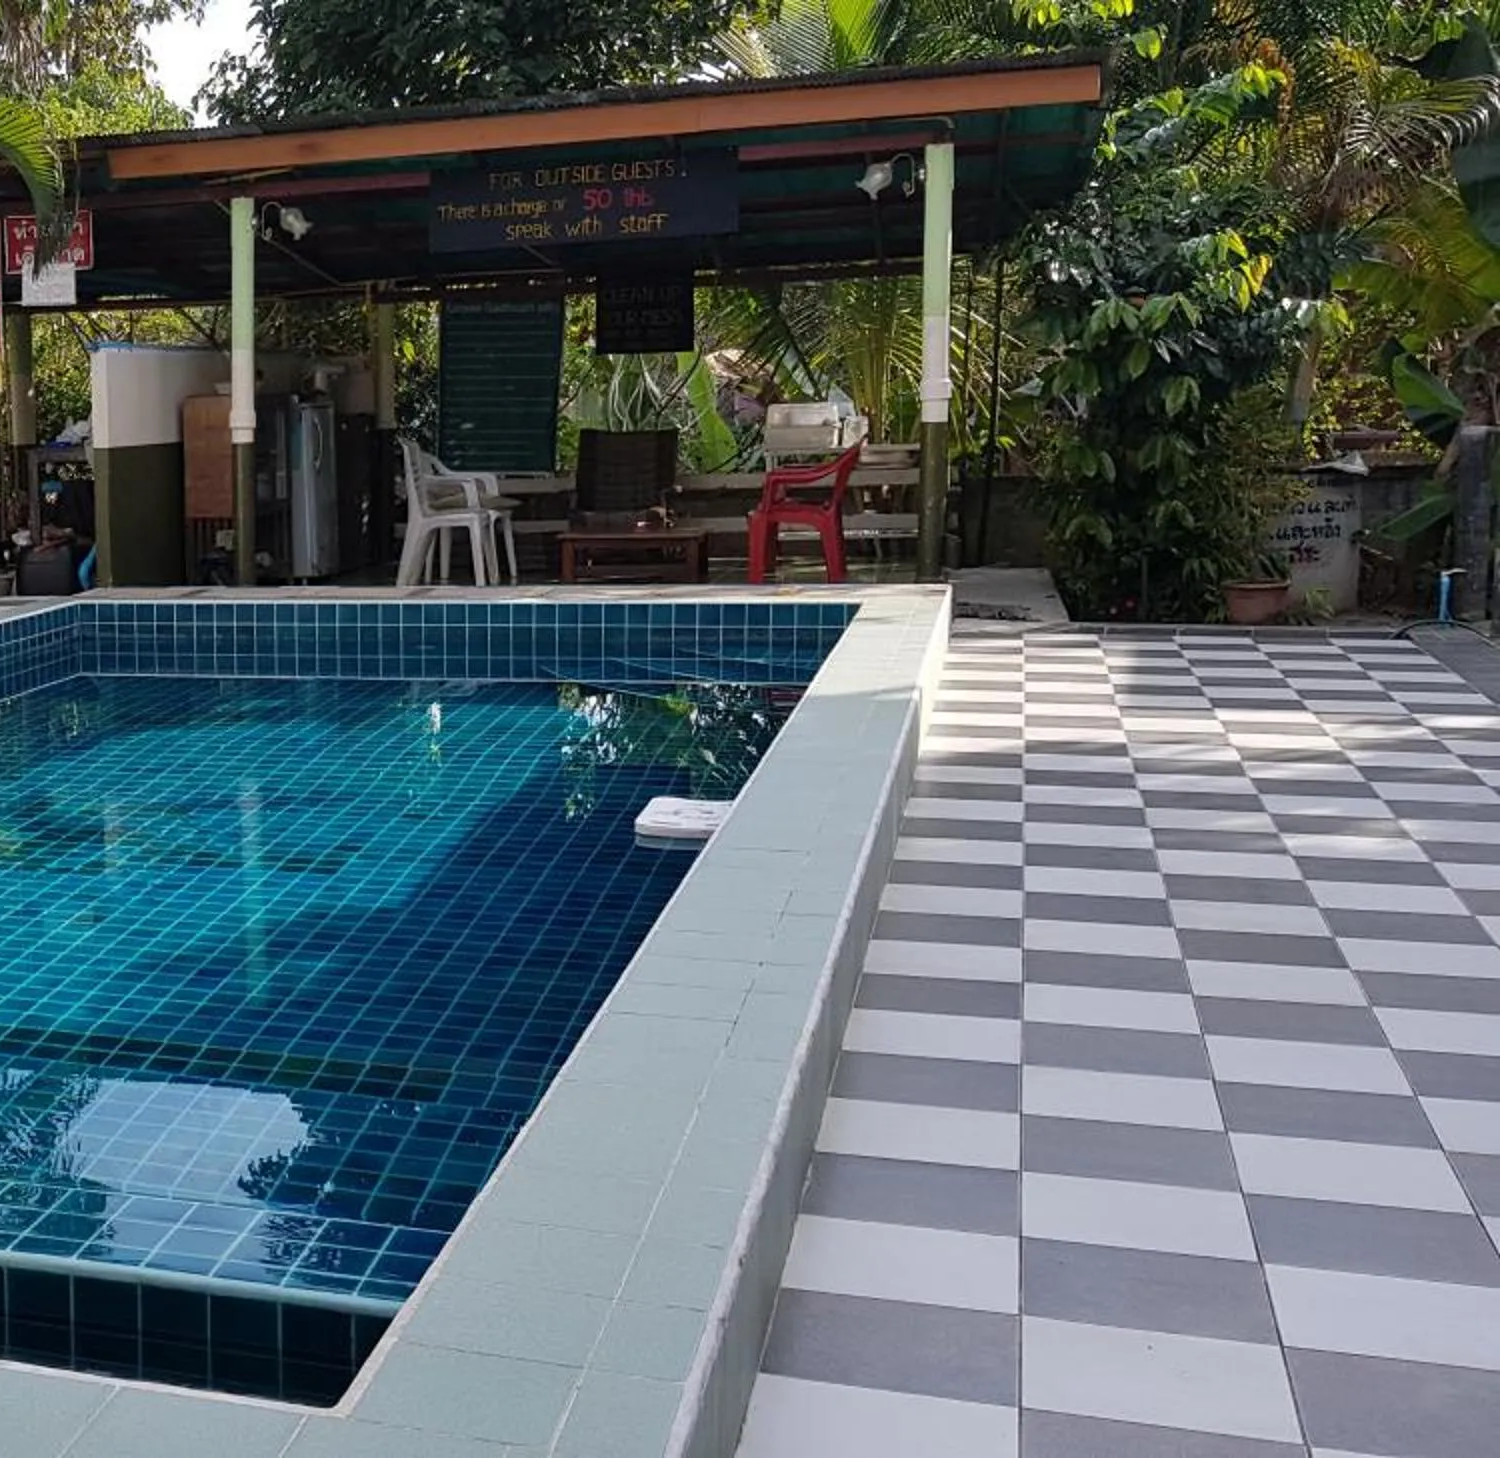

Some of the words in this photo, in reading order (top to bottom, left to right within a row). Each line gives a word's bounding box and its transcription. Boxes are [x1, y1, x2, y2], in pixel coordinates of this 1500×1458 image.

[489, 171, 523, 192] FOR
[535, 163, 607, 187] OUTSIDE
[438, 202, 476, 221] There
[583, 188, 613, 210] 50
[565, 215, 602, 237] with
[619, 213, 669, 234] staff
